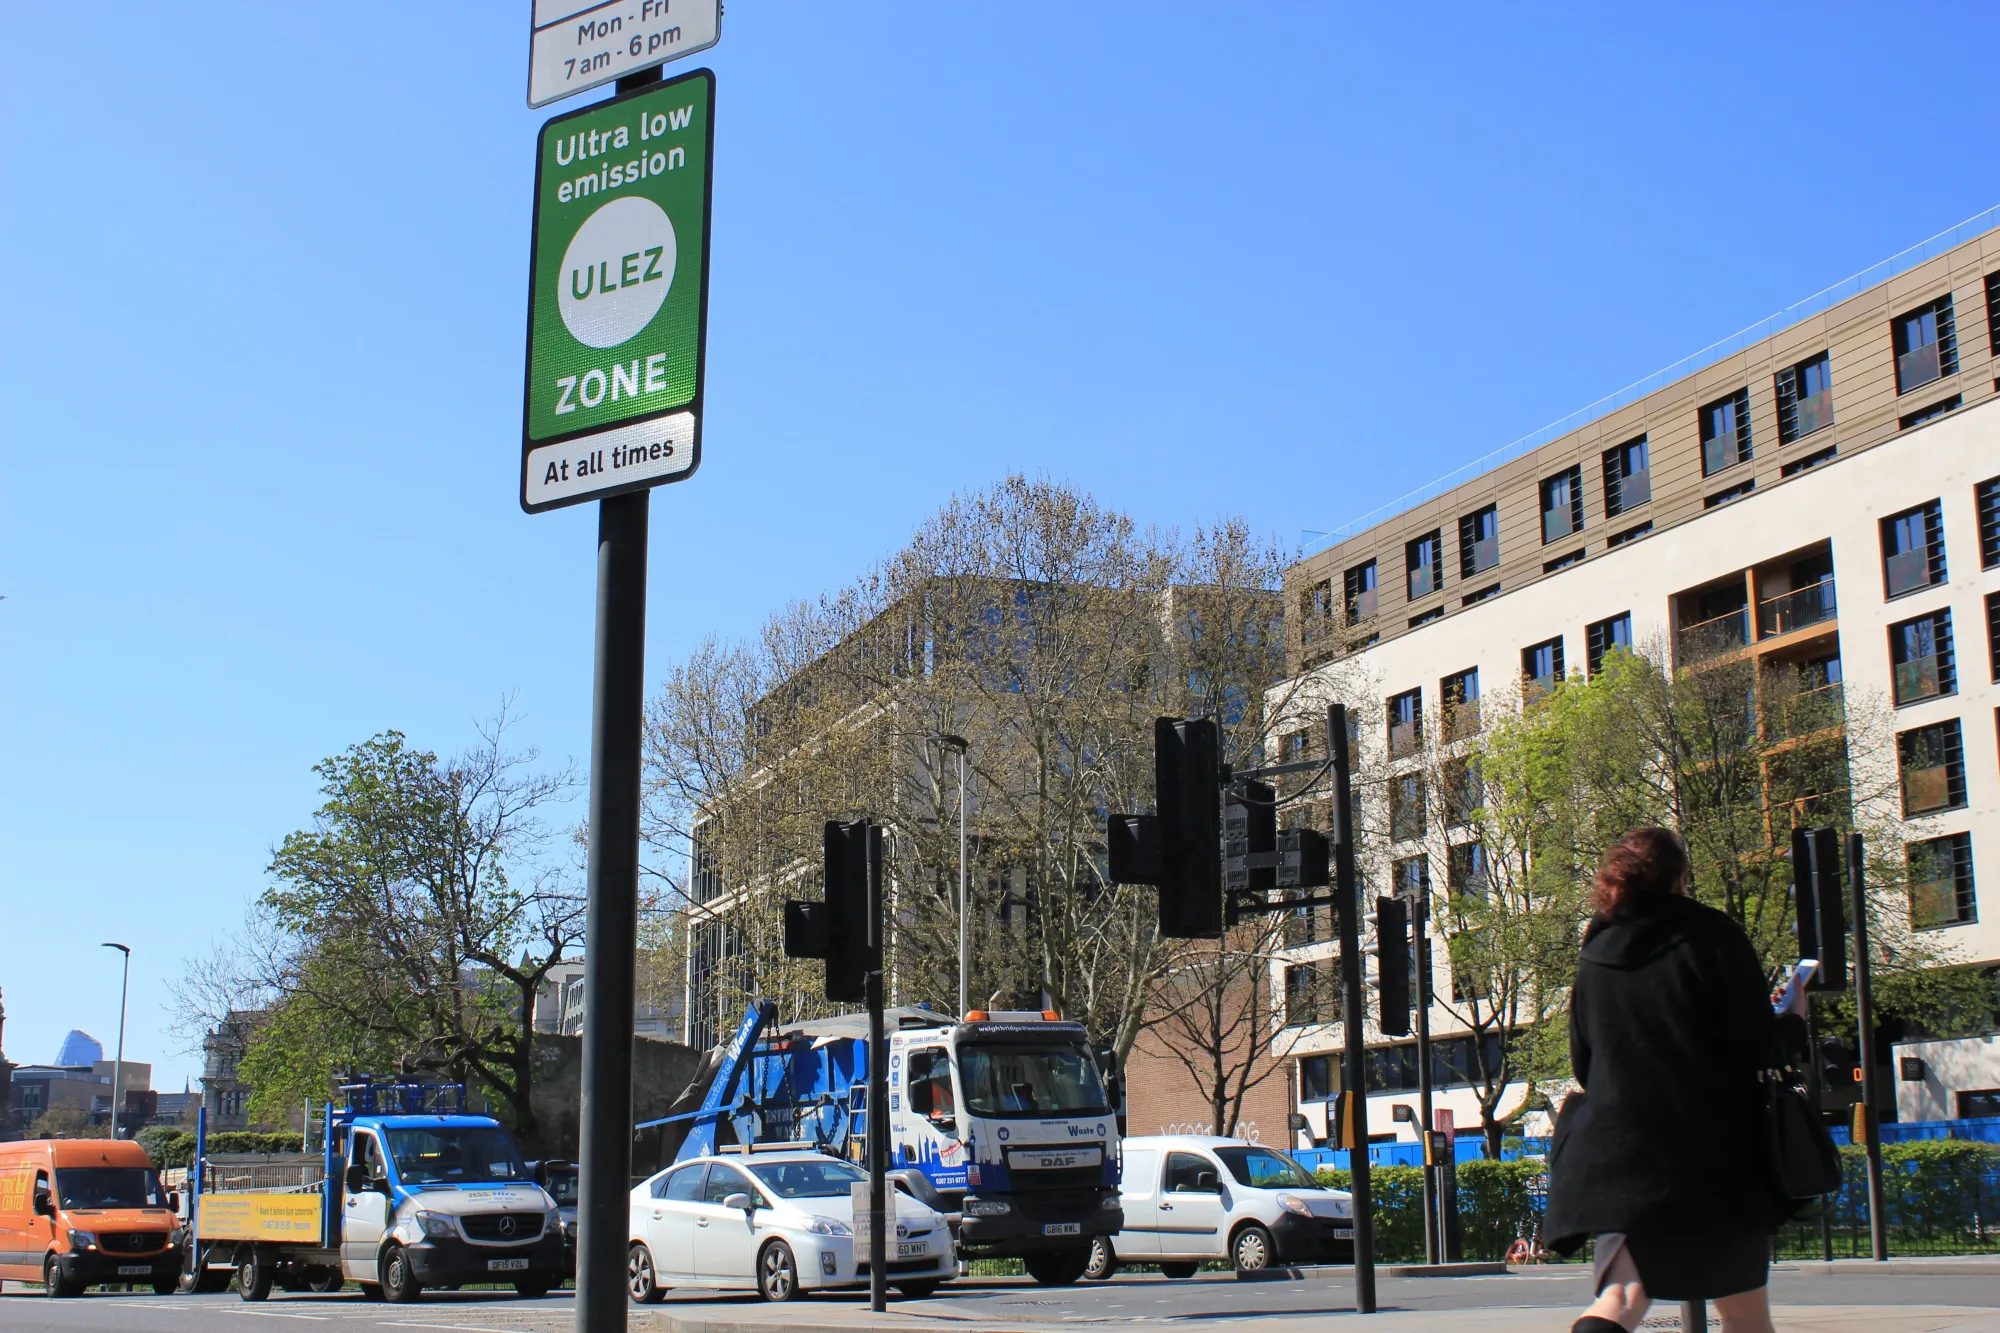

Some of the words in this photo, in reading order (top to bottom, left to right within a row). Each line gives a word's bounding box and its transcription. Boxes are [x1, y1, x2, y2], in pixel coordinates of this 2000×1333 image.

[578, 16, 623, 46] Mon
[641, 0, 670, 24] Fri
[556, 126, 630, 167] Ultra
[640, 104, 694, 141] low
[557, 146, 686, 203] emission
[572, 245, 664, 301] ULEZ
[555, 352, 668, 416] ZONE
[544, 461, 569, 485] At
[576, 450, 604, 478] all
[612, 439, 674, 470] times
[728, 1017, 753, 1062] Waste
[1068, 1125, 1095, 1137] Waste
[1041, 1157, 1076, 1167] DAF
[897, 1244, 909, 1254] 60
[911, 1243, 927, 1253] WNT
[1046, 1225, 1062, 1234] GB16
